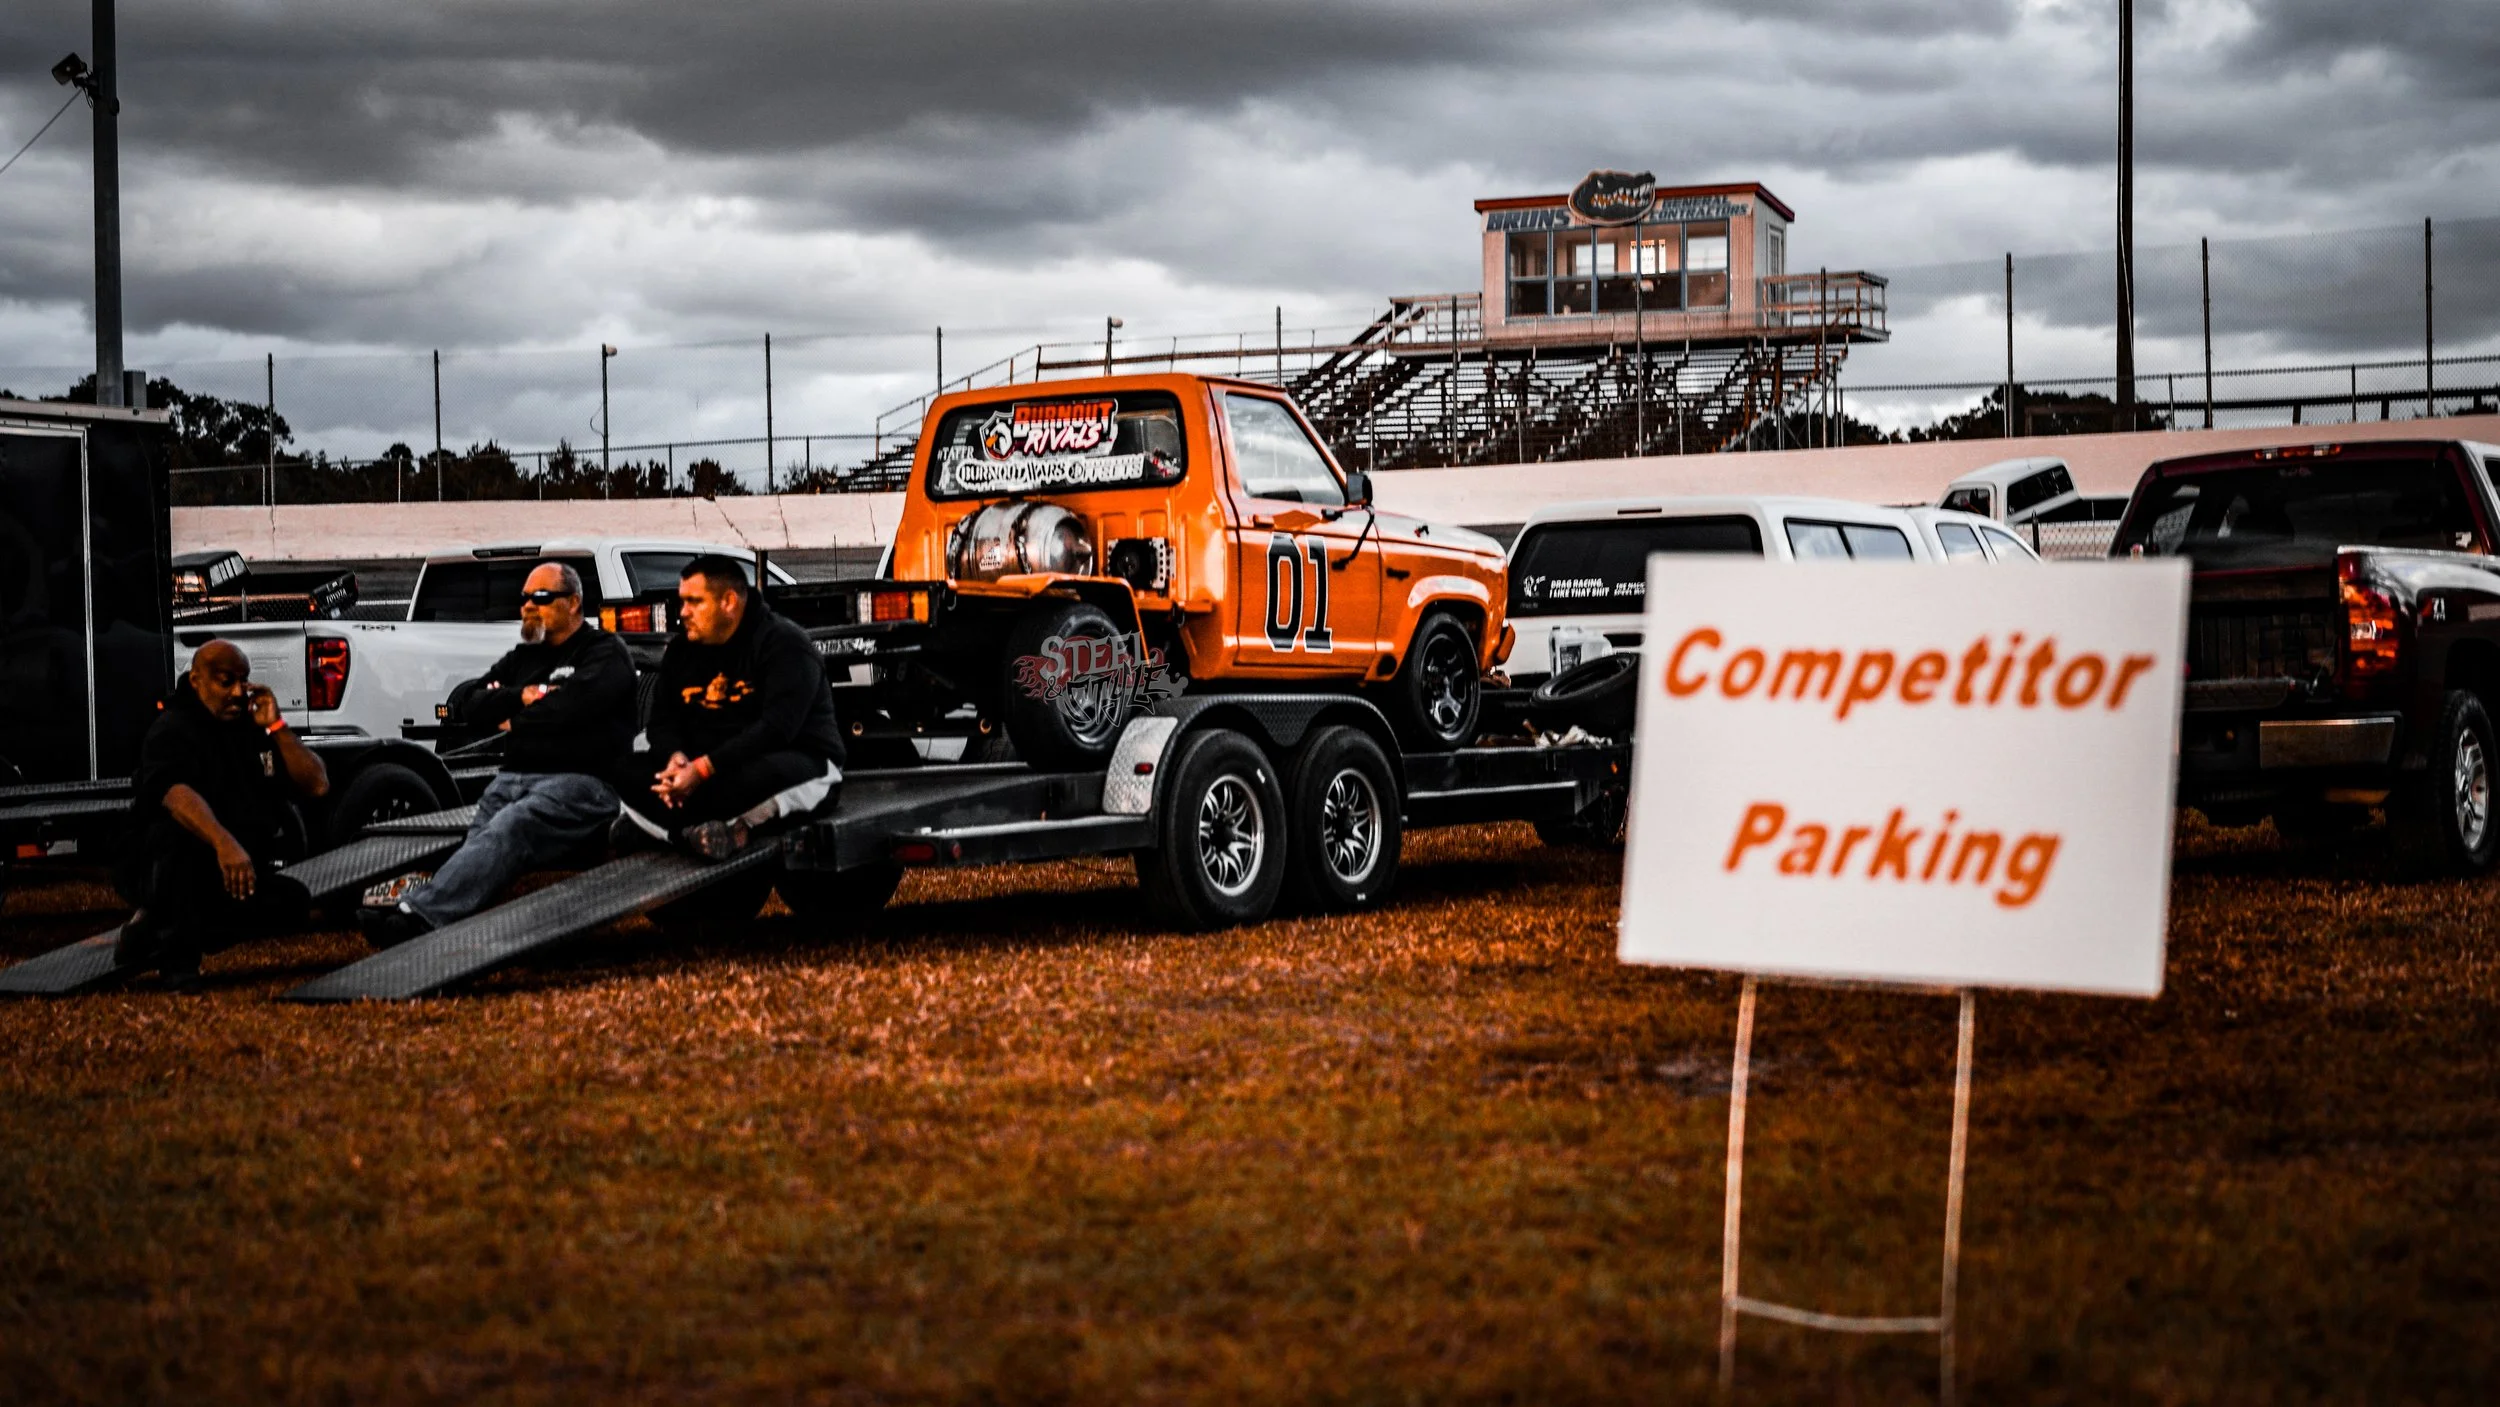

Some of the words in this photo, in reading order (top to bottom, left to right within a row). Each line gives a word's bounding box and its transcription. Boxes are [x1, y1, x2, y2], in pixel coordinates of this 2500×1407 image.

[1648, 203, 1748, 220] CONTRACTORS
[1661, 194, 1730, 208] GENERAL
[1486, 206, 1571, 231] BRUNS
[1013, 401, 1114, 437] BURNOUT
[1023, 422, 1103, 455] RIVALS
[1265, 532, 1333, 653] 01
[1550, 580, 1572, 589] DRAG
[1553, 588, 1570, 598] LIKE
[1571, 588, 1592, 598] THAT
[1662, 626, 2156, 722] Competitor
[1722, 801, 2062, 910] Parking
